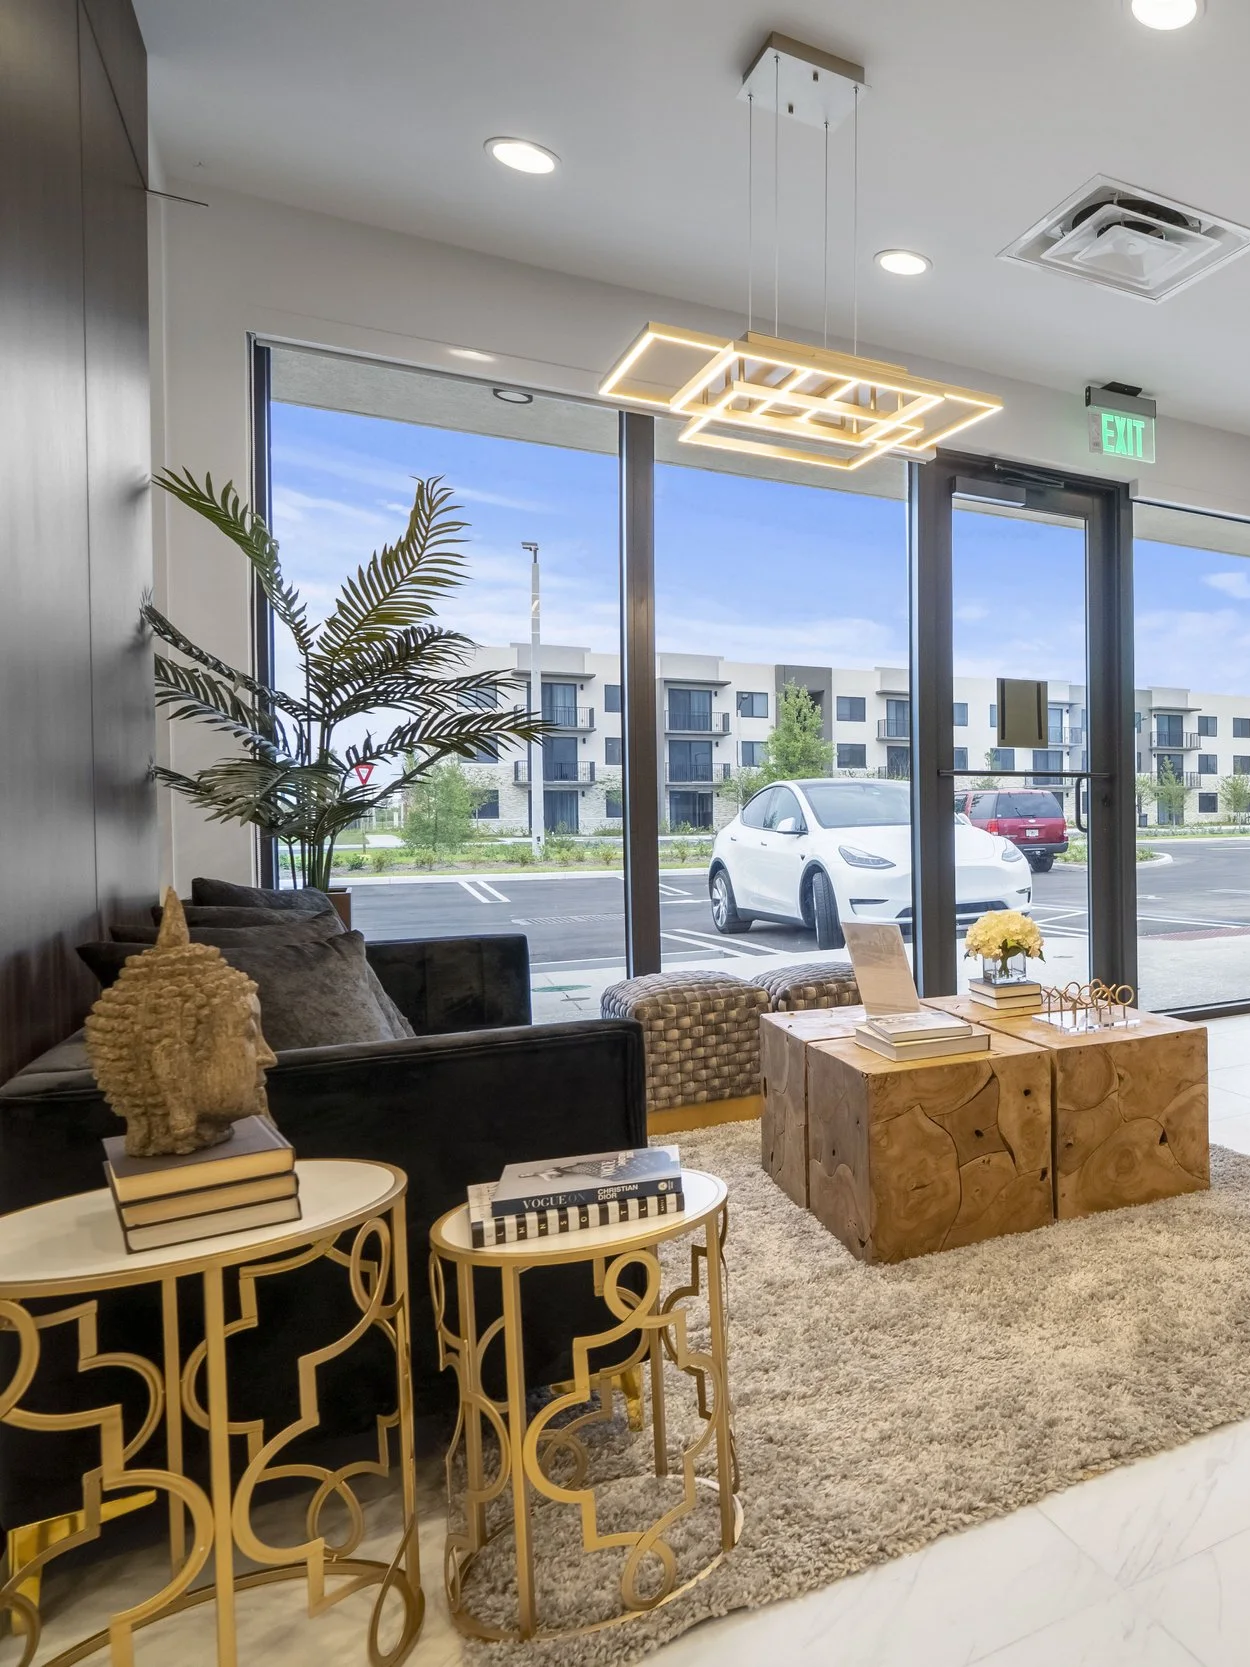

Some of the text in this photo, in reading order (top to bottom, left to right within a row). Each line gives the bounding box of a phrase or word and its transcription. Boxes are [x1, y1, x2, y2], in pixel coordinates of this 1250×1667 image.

[1101, 412, 1145, 458] EXIT
[597, 1184, 639, 1195] CHRISTIAN
[523, 1195, 567, 1209] VOGUE
[597, 1192, 618, 1201] DIOR
